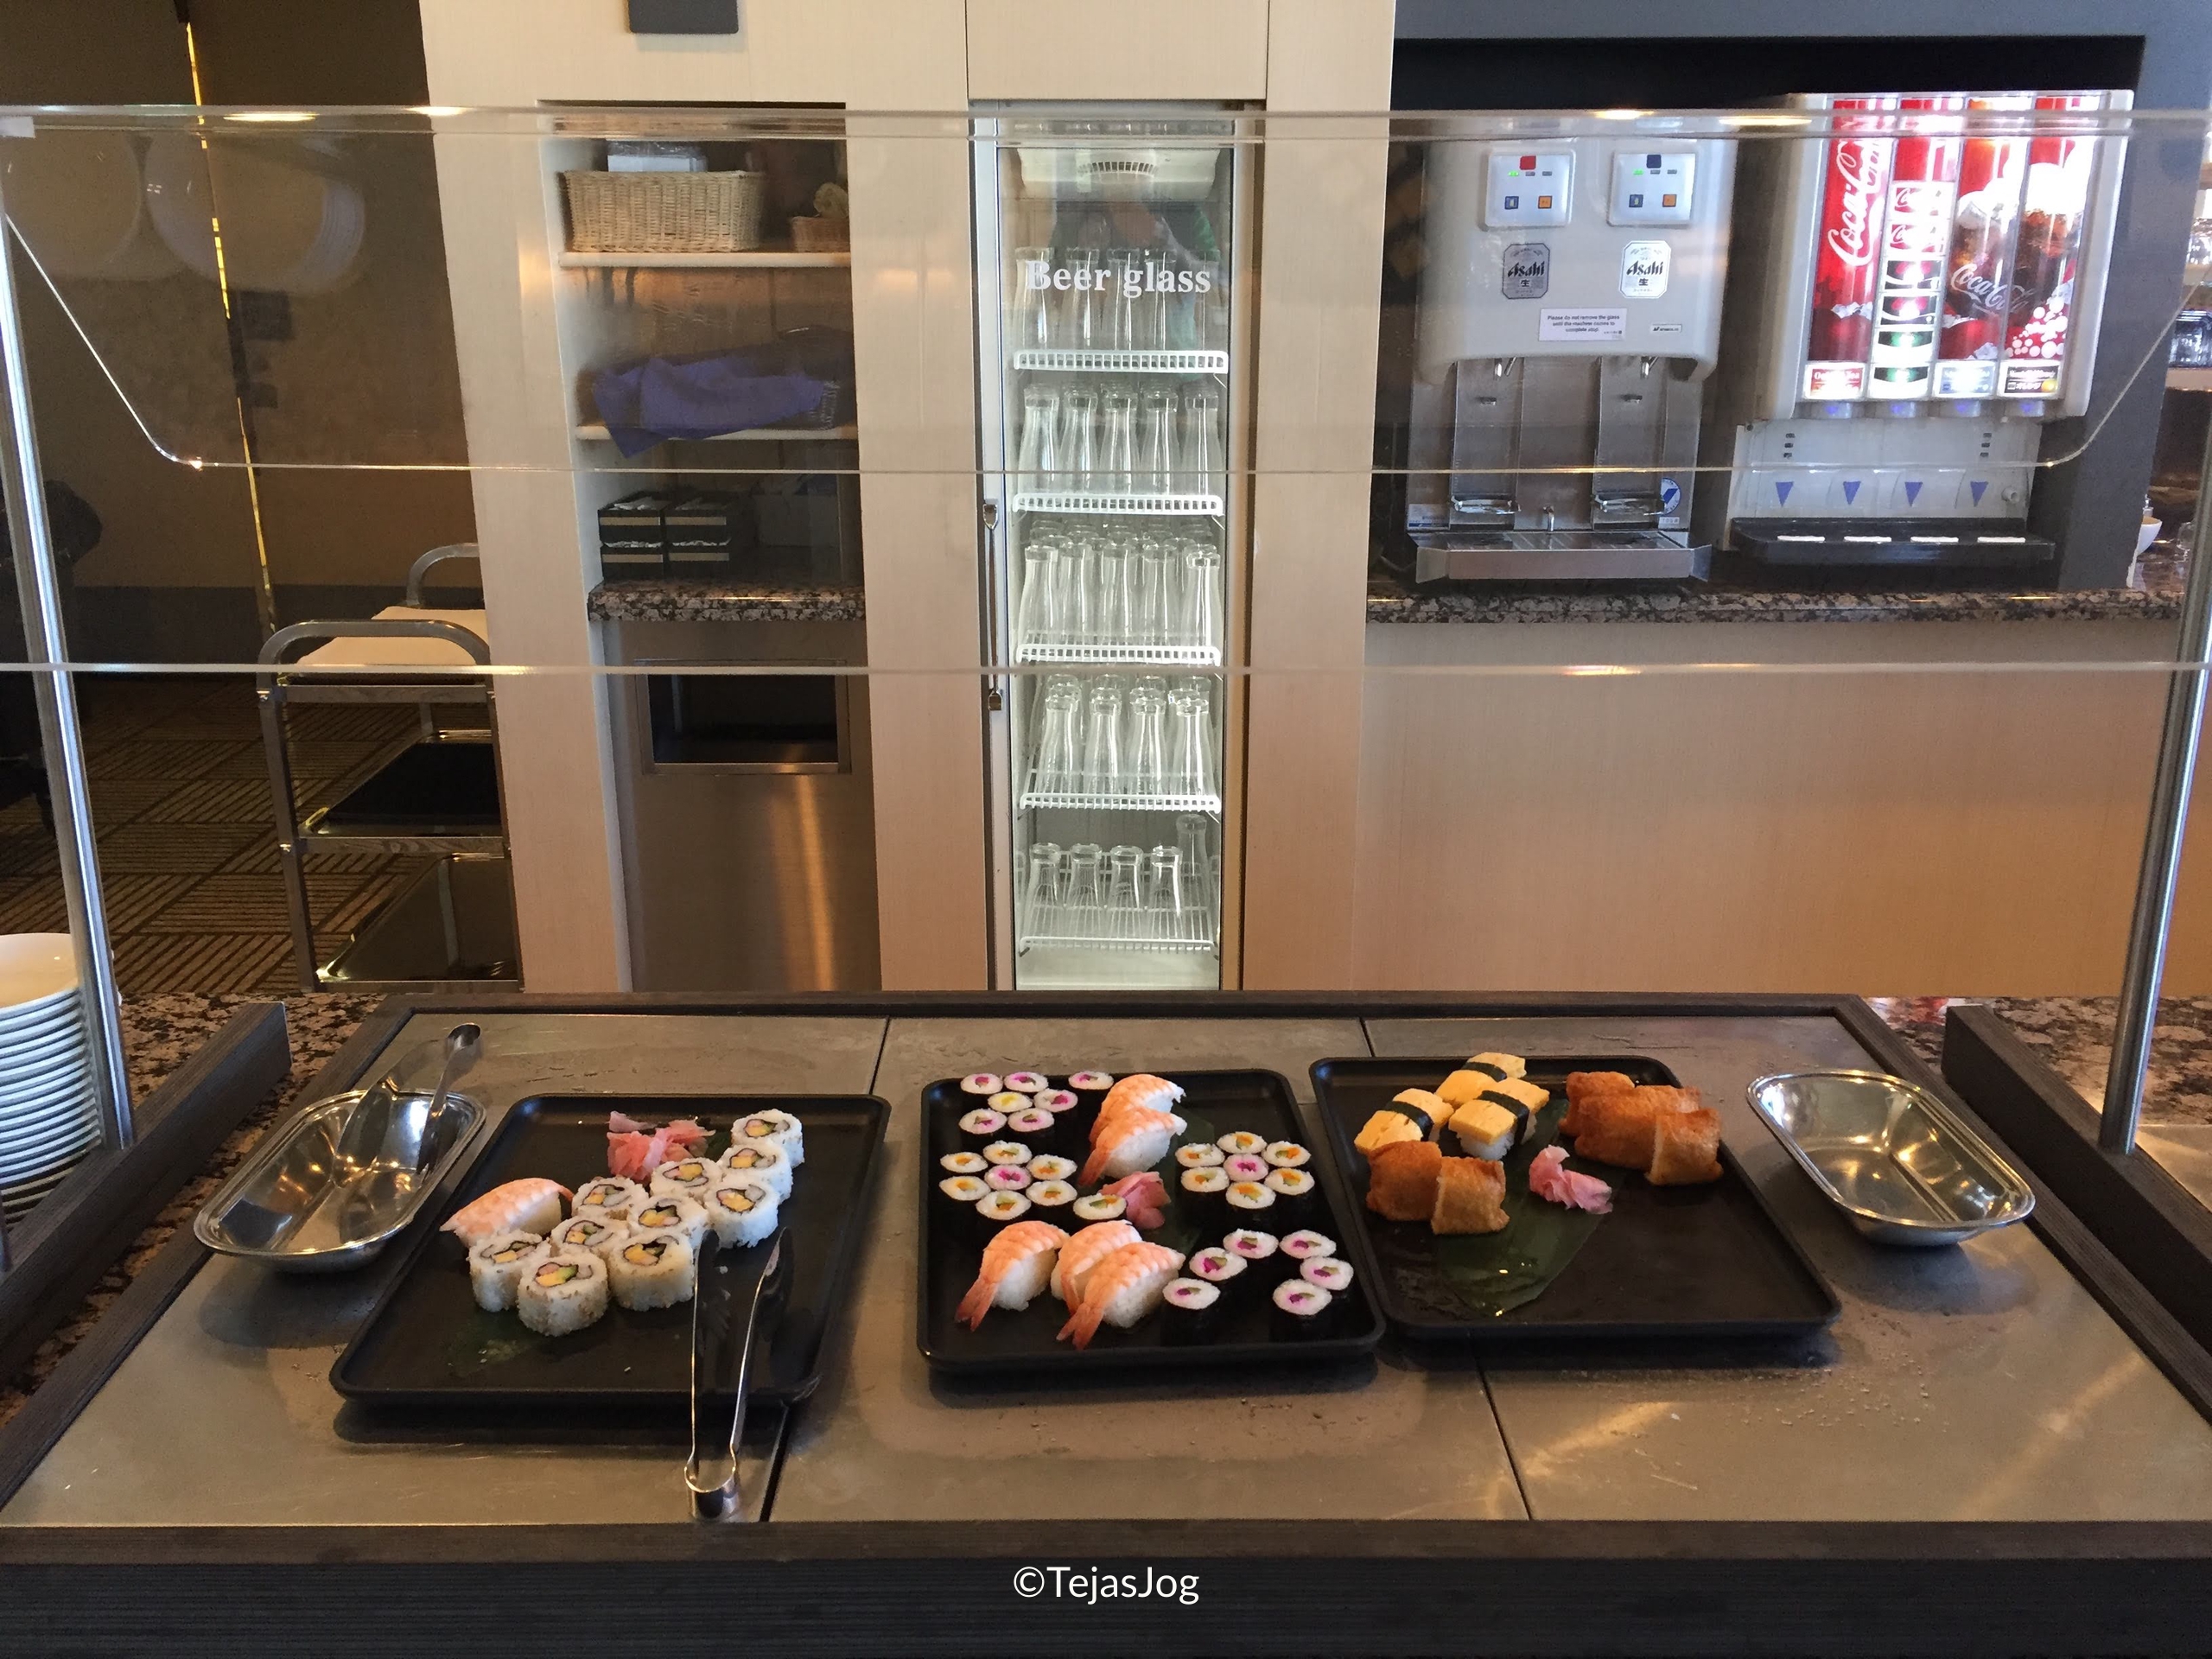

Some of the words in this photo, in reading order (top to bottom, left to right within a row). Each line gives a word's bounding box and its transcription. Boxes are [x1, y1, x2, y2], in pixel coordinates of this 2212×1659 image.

[1507, 261, 1545, 277] Asahi
[1626, 260, 1664, 276] Asahi
[1025, 260, 1112, 292] Beer
[1122, 260, 1212, 299] glass
[1520, 279, 1530, 288] 生
[1638, 277, 1649, 287] 生
